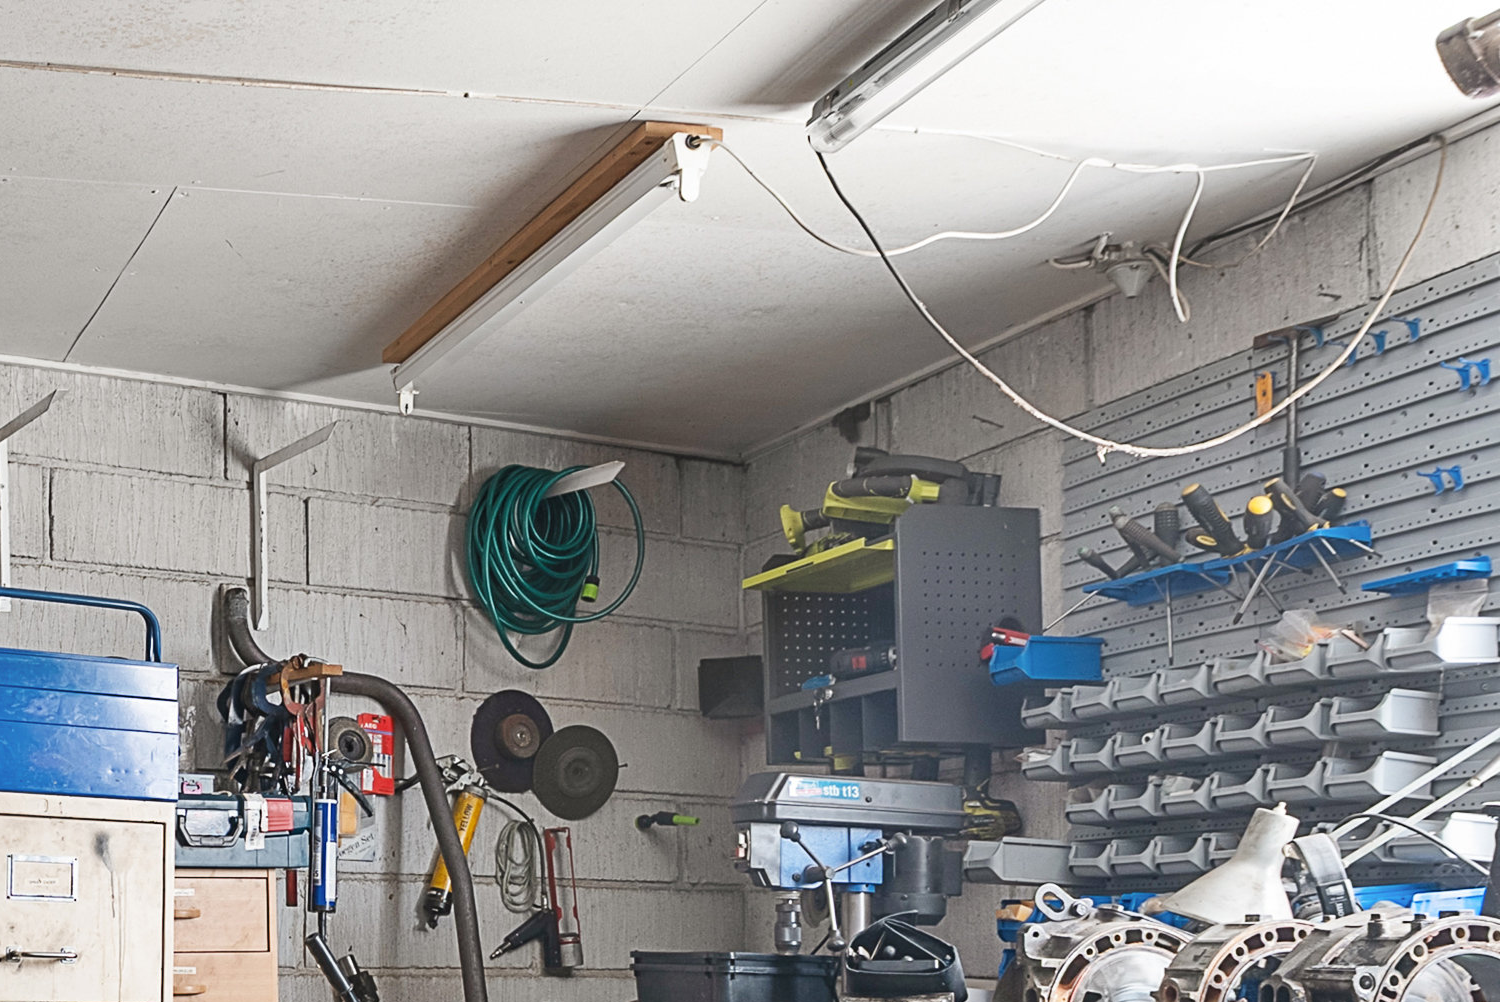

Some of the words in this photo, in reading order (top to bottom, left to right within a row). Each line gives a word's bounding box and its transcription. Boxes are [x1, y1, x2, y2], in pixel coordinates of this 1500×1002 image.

[823, 785, 839, 796] stb
[842, 785, 859, 798] t13
[459, 803, 473, 831] YELLOW
